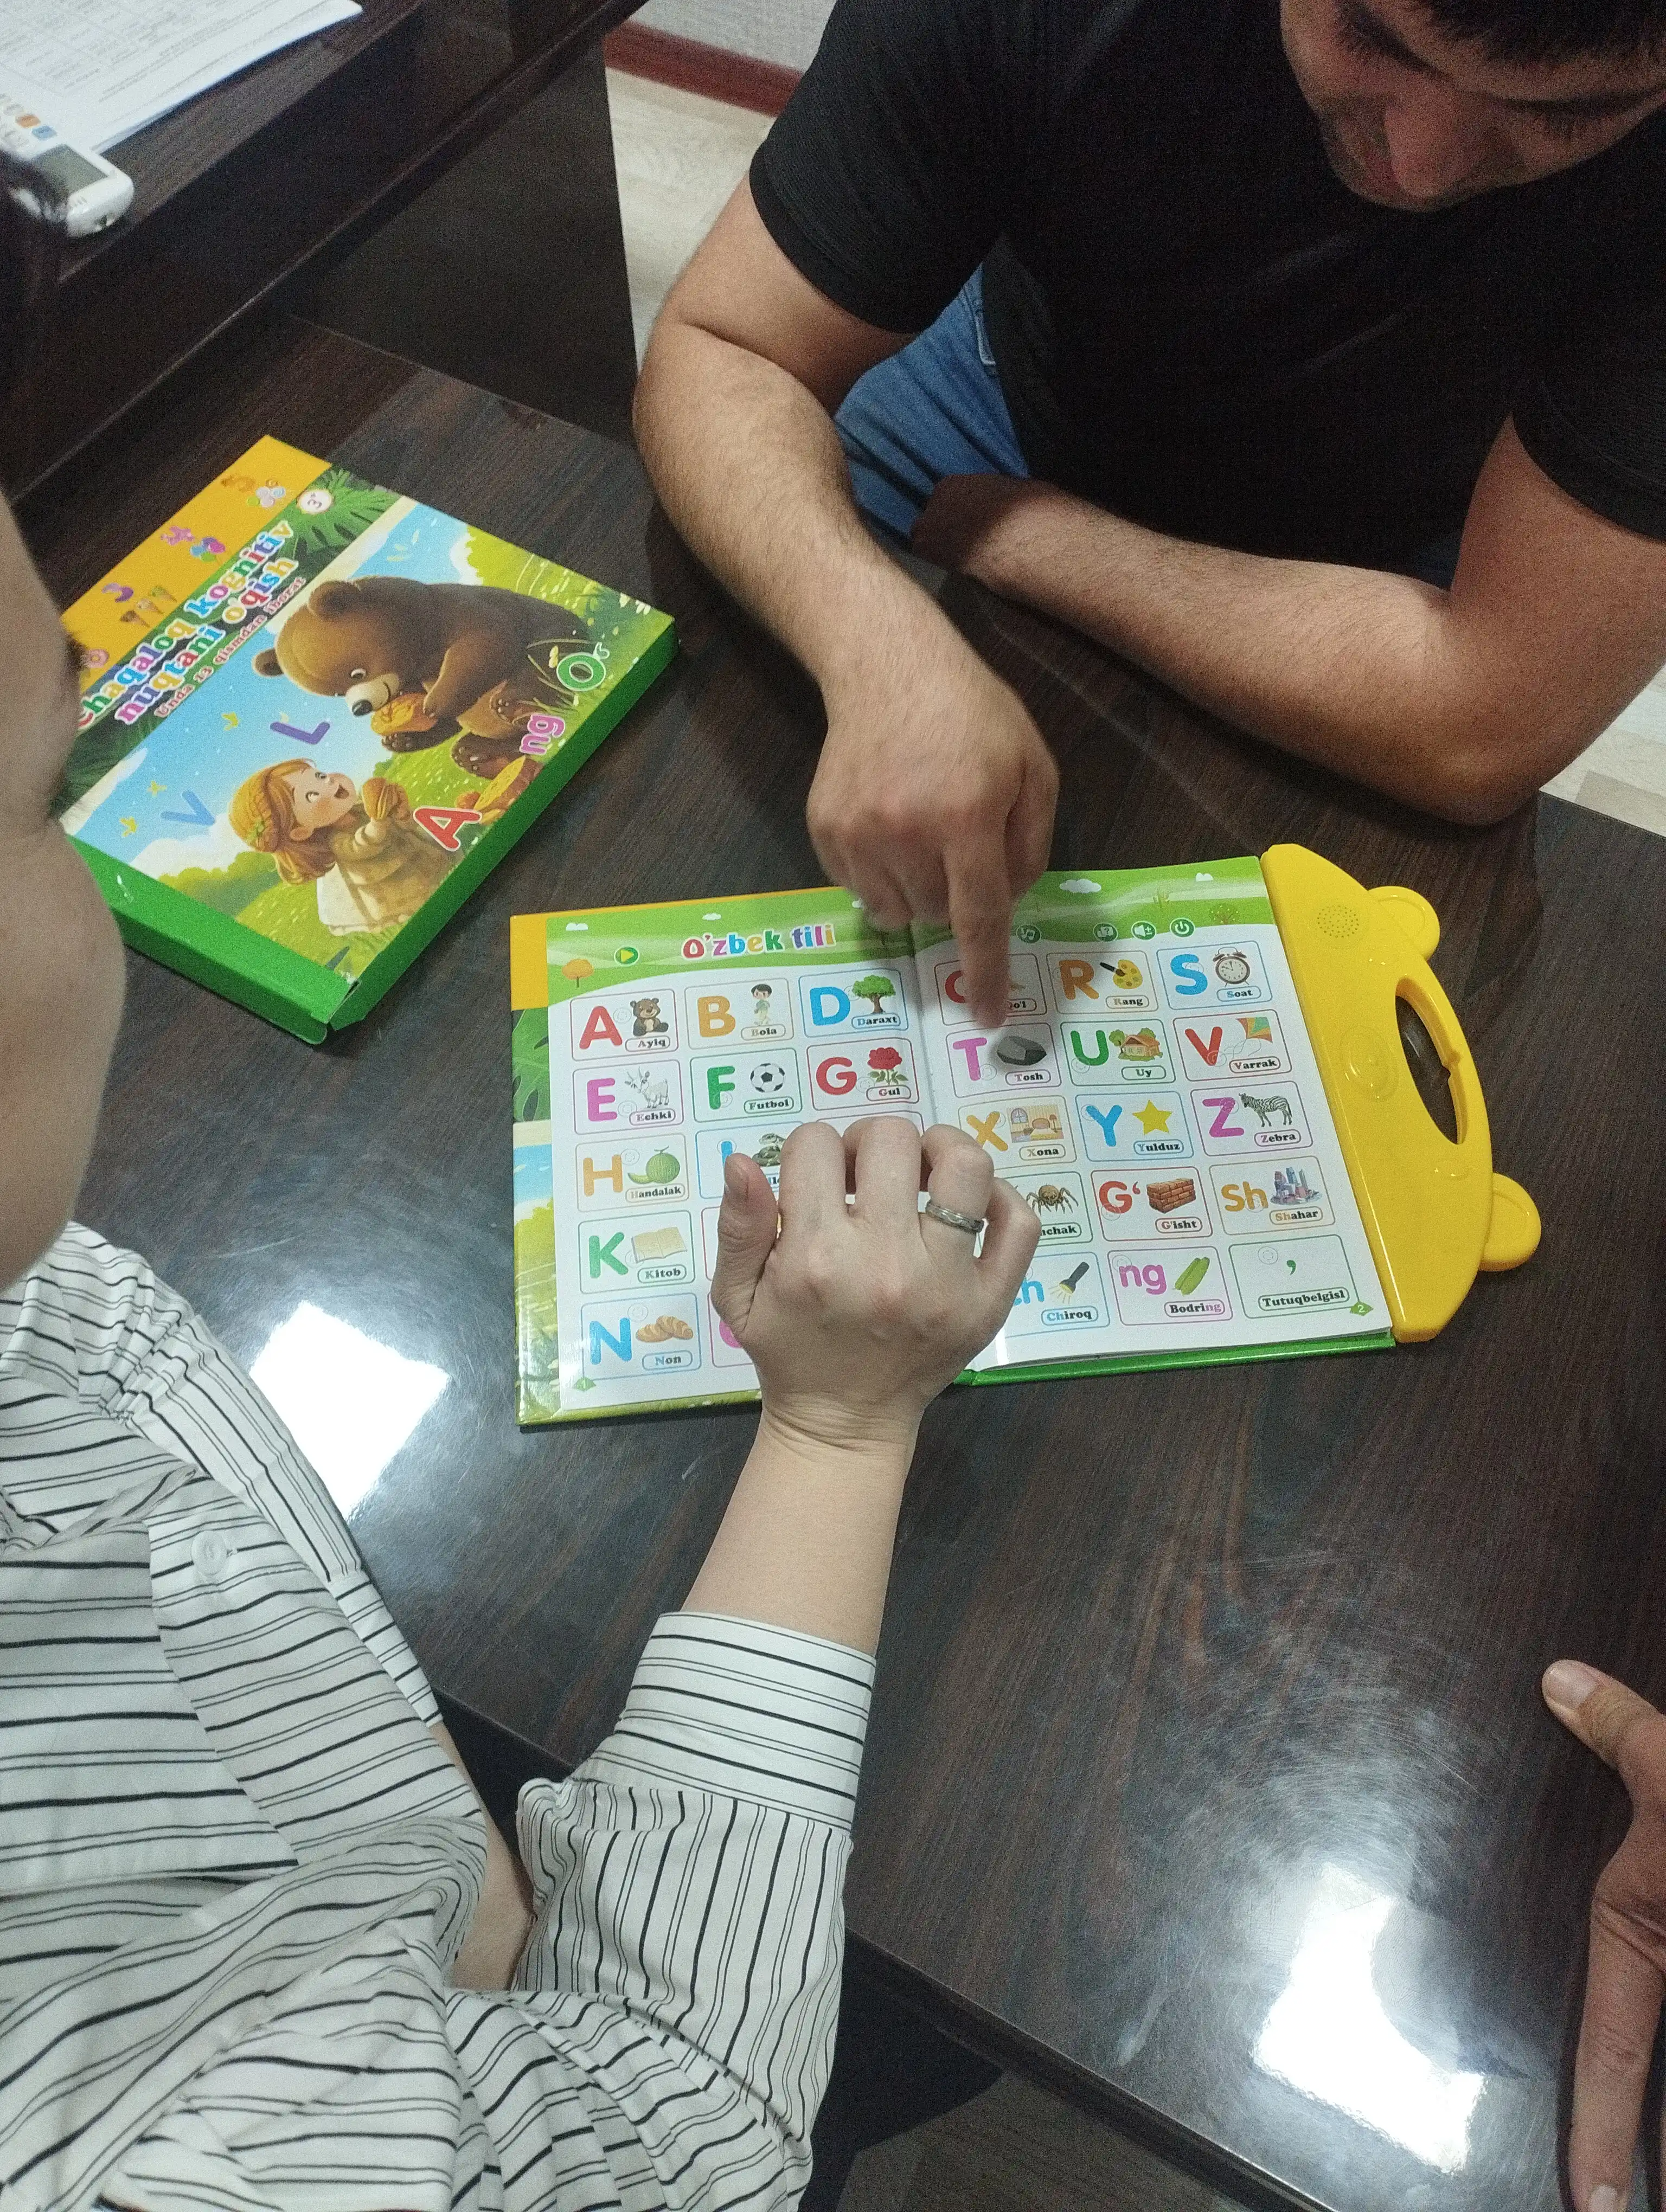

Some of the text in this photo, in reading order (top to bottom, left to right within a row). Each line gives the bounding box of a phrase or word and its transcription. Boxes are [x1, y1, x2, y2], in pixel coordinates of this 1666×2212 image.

[185, 522, 292, 616] kognitiv
[117, 626, 223, 722] nuqtani
[155, 684, 194, 716] Unda
[270, 722, 330, 744] L
[519, 713, 566, 755] ng
[161, 789, 215, 826] V
[413, 806, 482, 851] A
[682, 924, 835, 959] O'zbek tili
[1059, 960, 1099, 1000] R
[1170, 954, 1208, 995] S
[810, 987, 850, 1026] D
[1113, 998, 1143, 1007] Rang
[1226, 989, 1253, 998] Soat
[579, 1006, 623, 1050] A
[697, 996, 736, 1037] B
[750, 1027, 777, 1037] Bola
[857, 1017, 898, 1026] Daraxt
[637, 1038, 667, 1049] Ayiq
[952, 1037, 988, 1081] T
[1070, 1030, 1109, 1066] U
[1184, 1026, 1223, 1066] V
[816, 1057, 857, 1096] G
[1014, 1072, 1044, 1082] Tosh
[1136, 1069, 1152, 1078] Uy
[1234, 1059, 1277, 1070] Varrak
[587, 1078, 618, 1122] E
[707, 1066, 735, 1110] F
[879, 1088, 901, 1097] Gul
[636, 1110, 672, 1122] Echki
[748, 1099, 789, 1110] Futbol
[1202, 1097, 1245, 1137] Z
[966, 1111, 1009, 1152] X
[1086, 1104, 1123, 1147] Y
[1260, 1133, 1296, 1143] Zebra
[1027, 1147, 1059, 1157] Xona
[1137, 1143, 1181, 1152] Yulduz
[583, 1154, 623, 1197] H
[630, 1186, 682, 1199] Handalak
[1221, 1181, 1269, 1212] Sh
[1161, 1220, 1197, 1230] G'isht
[1275, 1210, 1318, 1221] Shahar
[588, 1232, 629, 1278] K
[644, 1268, 681, 1280] Kitob
[1119, 1264, 1167, 1295] ng
[1013, 1277, 1045, 1306] h
[1046, 1310, 1093, 1321] Chiroq
[1169, 1302, 1221, 1313] Bodring
[589, 1317, 632, 1365] N
[654, 1355, 682, 1366] Non
